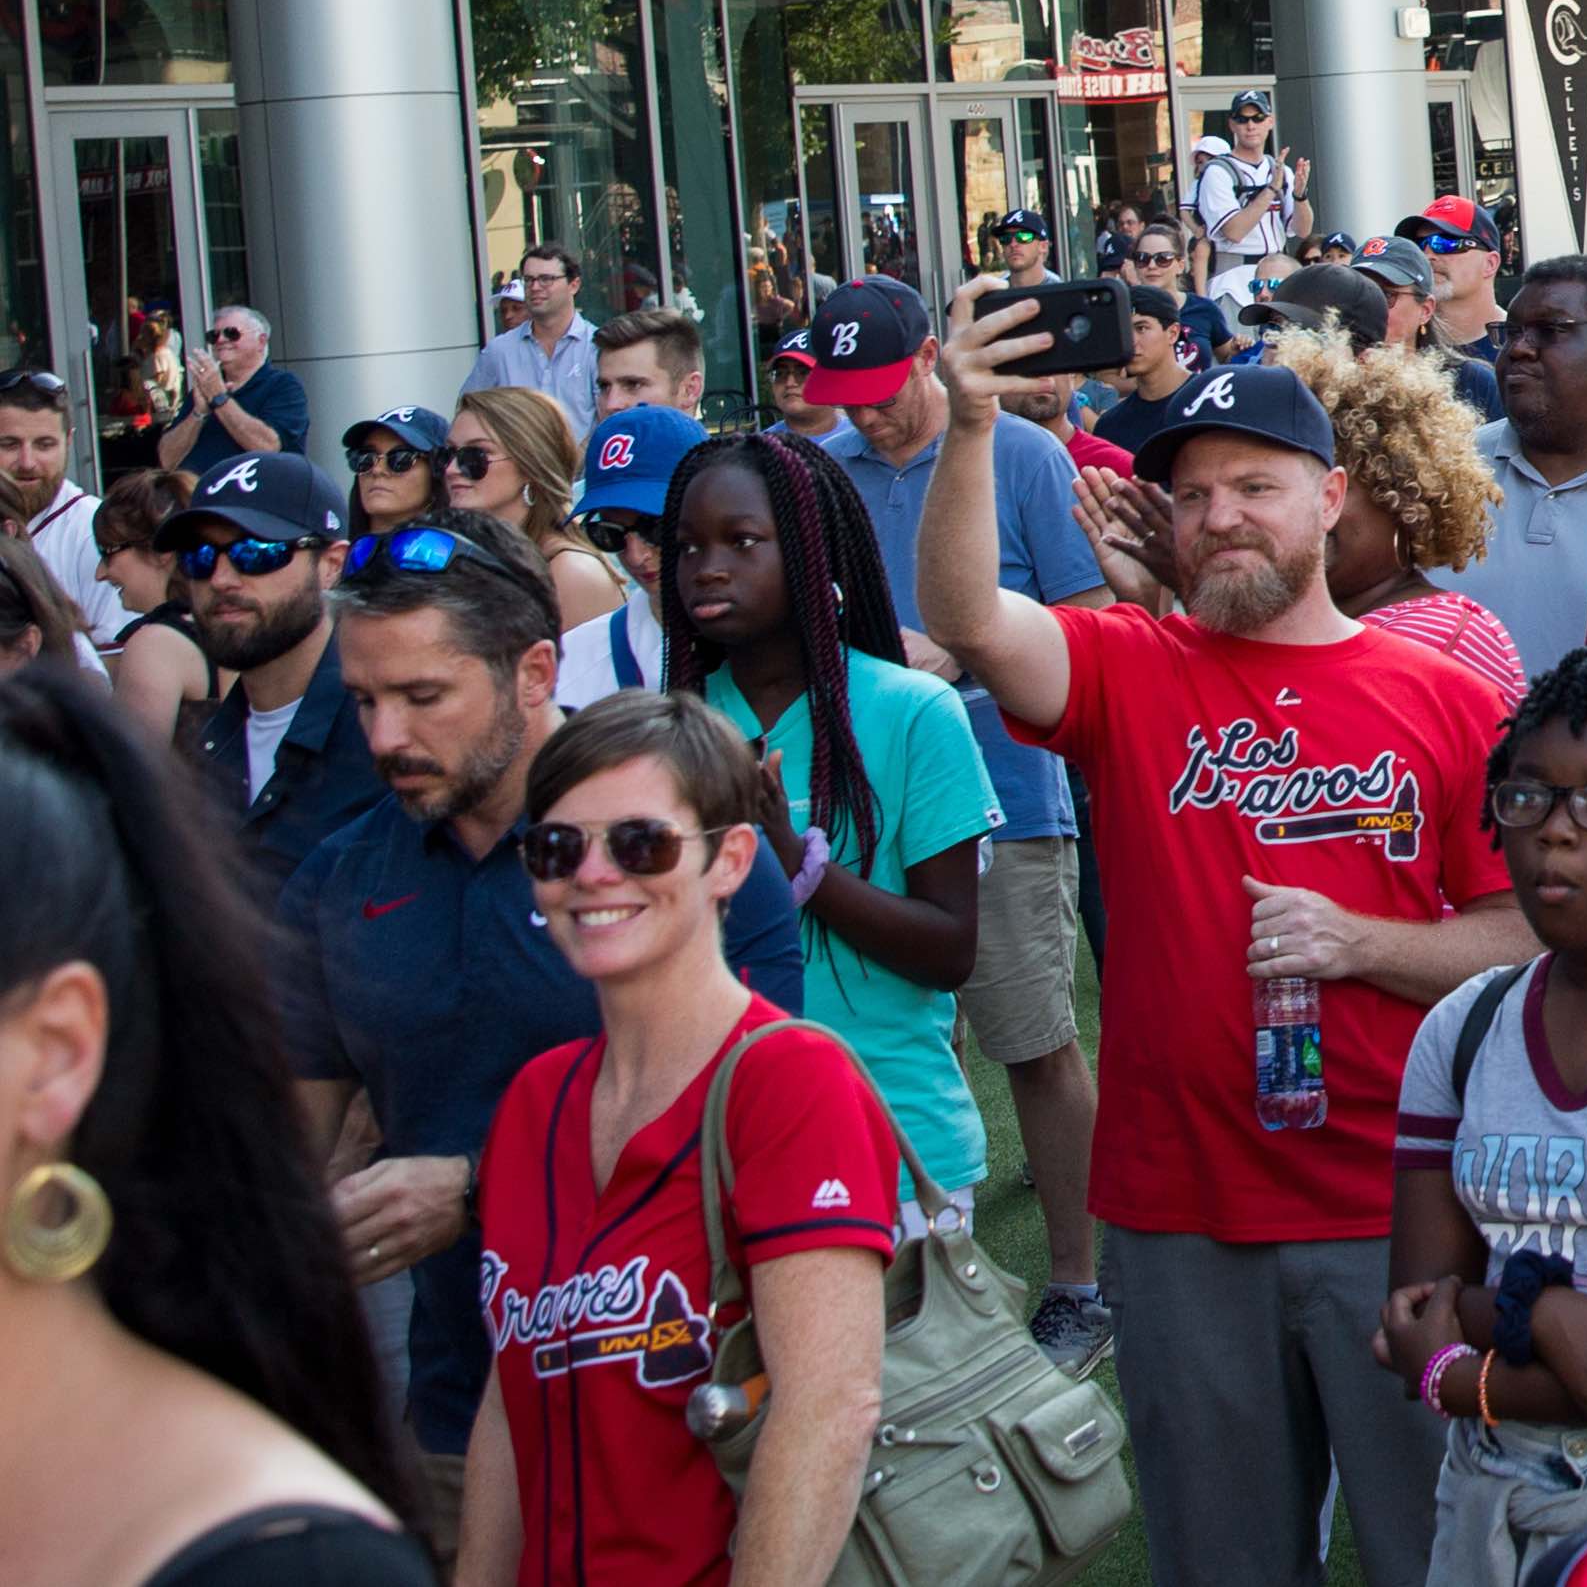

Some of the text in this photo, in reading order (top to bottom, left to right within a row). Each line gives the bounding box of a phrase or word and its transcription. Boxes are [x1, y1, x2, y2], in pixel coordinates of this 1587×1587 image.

[967, 103, 985, 116] 400
[831, 321, 859, 357] B
[1183, 371, 1236, 418] A
[206, 458, 260, 495] A
[1218, 717, 1298, 772] Los
